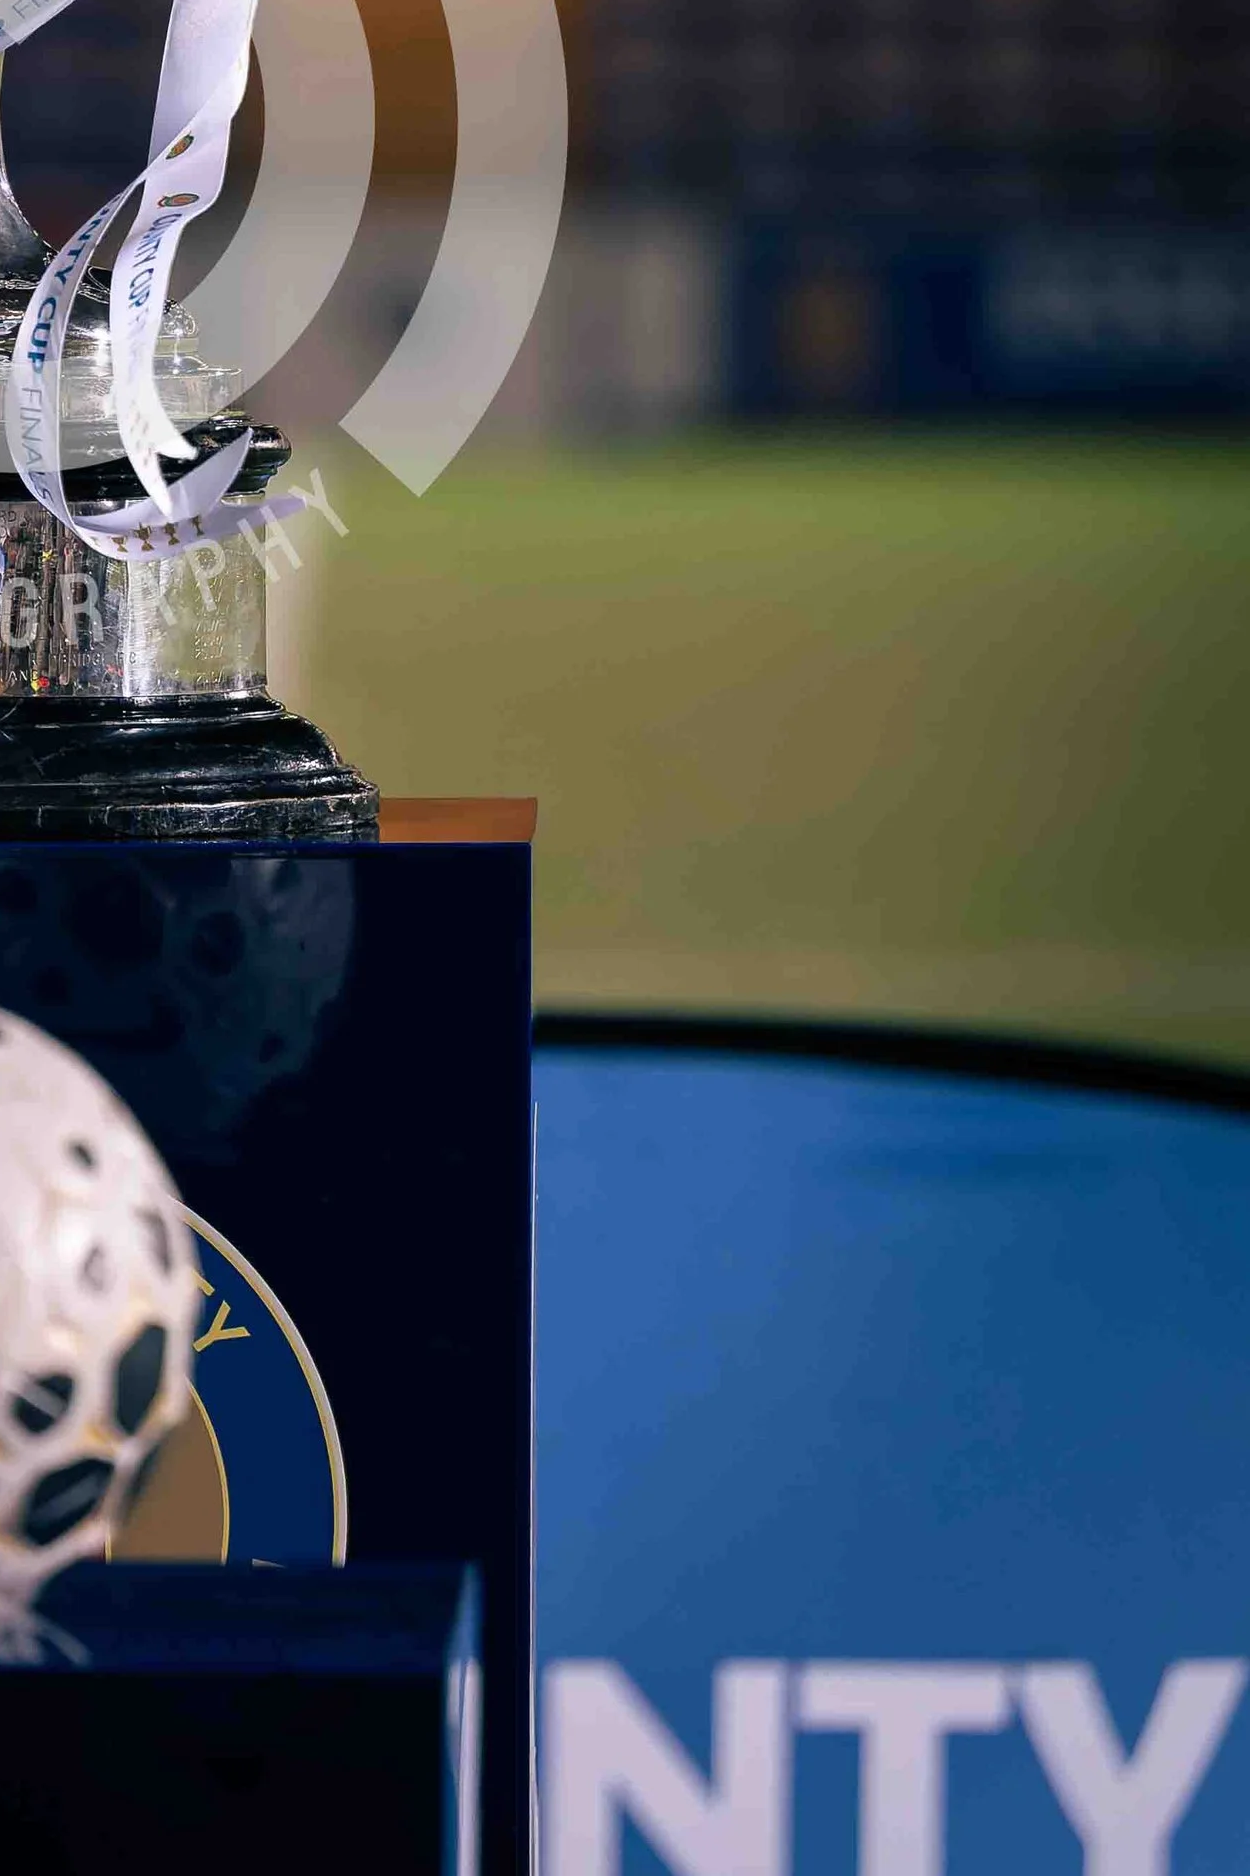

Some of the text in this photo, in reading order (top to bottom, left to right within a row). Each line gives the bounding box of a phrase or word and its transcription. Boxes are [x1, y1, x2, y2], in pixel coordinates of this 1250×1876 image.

[19, 212, 106, 505] NTY CUP FINALS
[542, 1657, 1248, 1876] NTY
